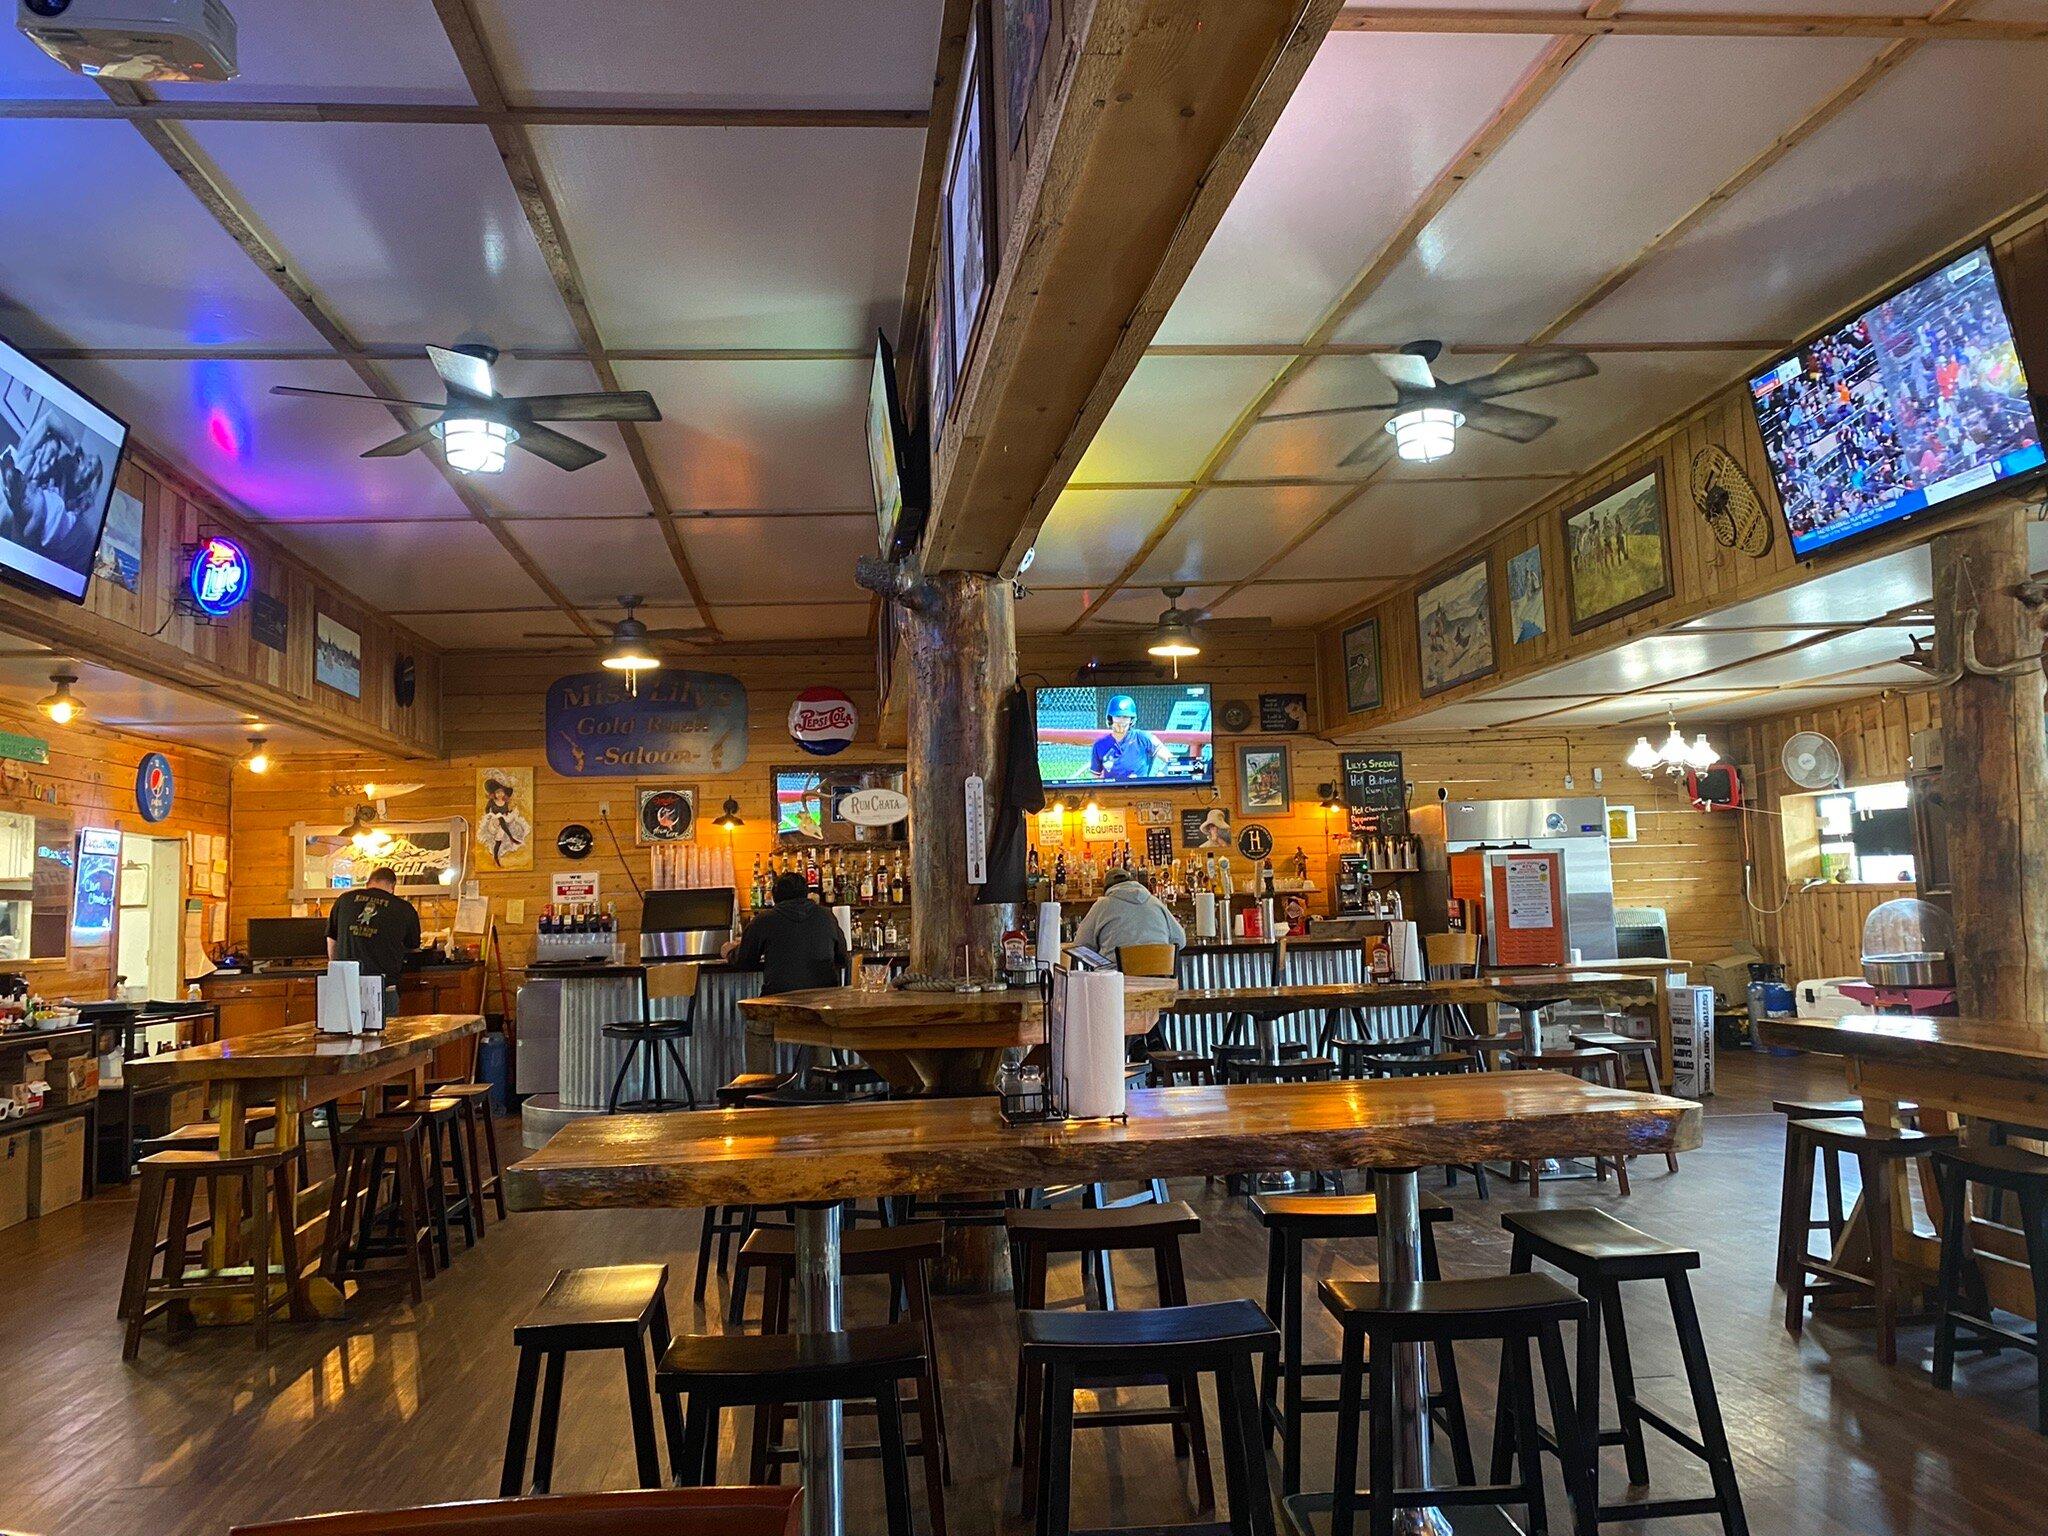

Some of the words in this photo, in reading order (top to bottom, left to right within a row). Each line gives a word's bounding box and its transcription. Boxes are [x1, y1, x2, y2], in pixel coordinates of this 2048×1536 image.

[577, 716, 635, 736] Gold
[1350, 774, 1363, 786] Hot
[1352, 806, 1363, 815] Hot
[1085, 824, 1123, 834] REQUIRED
[1701, 993, 1710, 1028] COTTON
[1703, 1030, 1711, 1060] CANDY
[1674, 1048, 1693, 1058] CANDY
